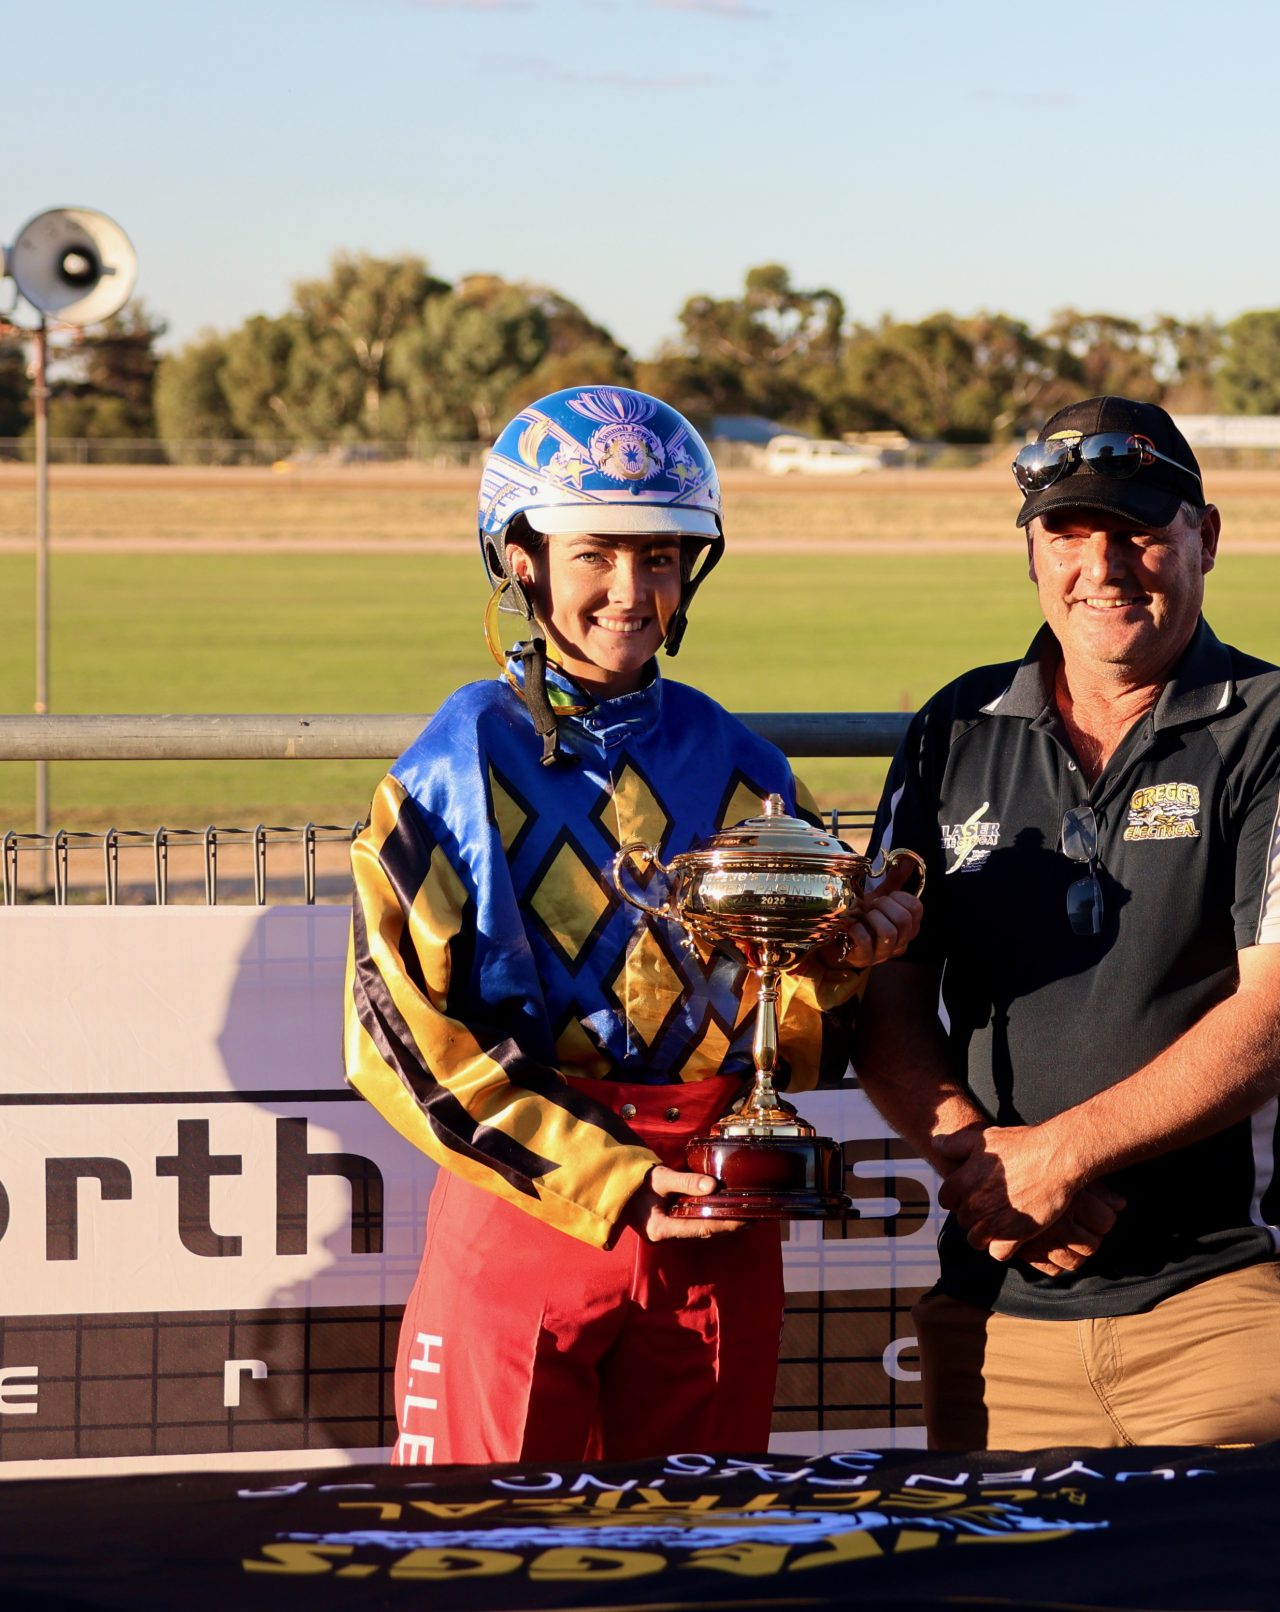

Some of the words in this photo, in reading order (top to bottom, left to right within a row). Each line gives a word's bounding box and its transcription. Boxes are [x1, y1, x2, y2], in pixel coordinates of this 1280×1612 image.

[597, 425, 628, 443] Hannah
[1130, 782, 1201, 811] GREGG'S
[940, 822, 1001, 839] LASER
[1123, 818, 1202, 841] ELECTRICAL
[760, 896, 787, 906] 2025
[0, 1117, 384, 1262] rth
[904, 1460, 1217, 1486] UYEN
[337, 1487, 1087, 1519] LECTRIAL
